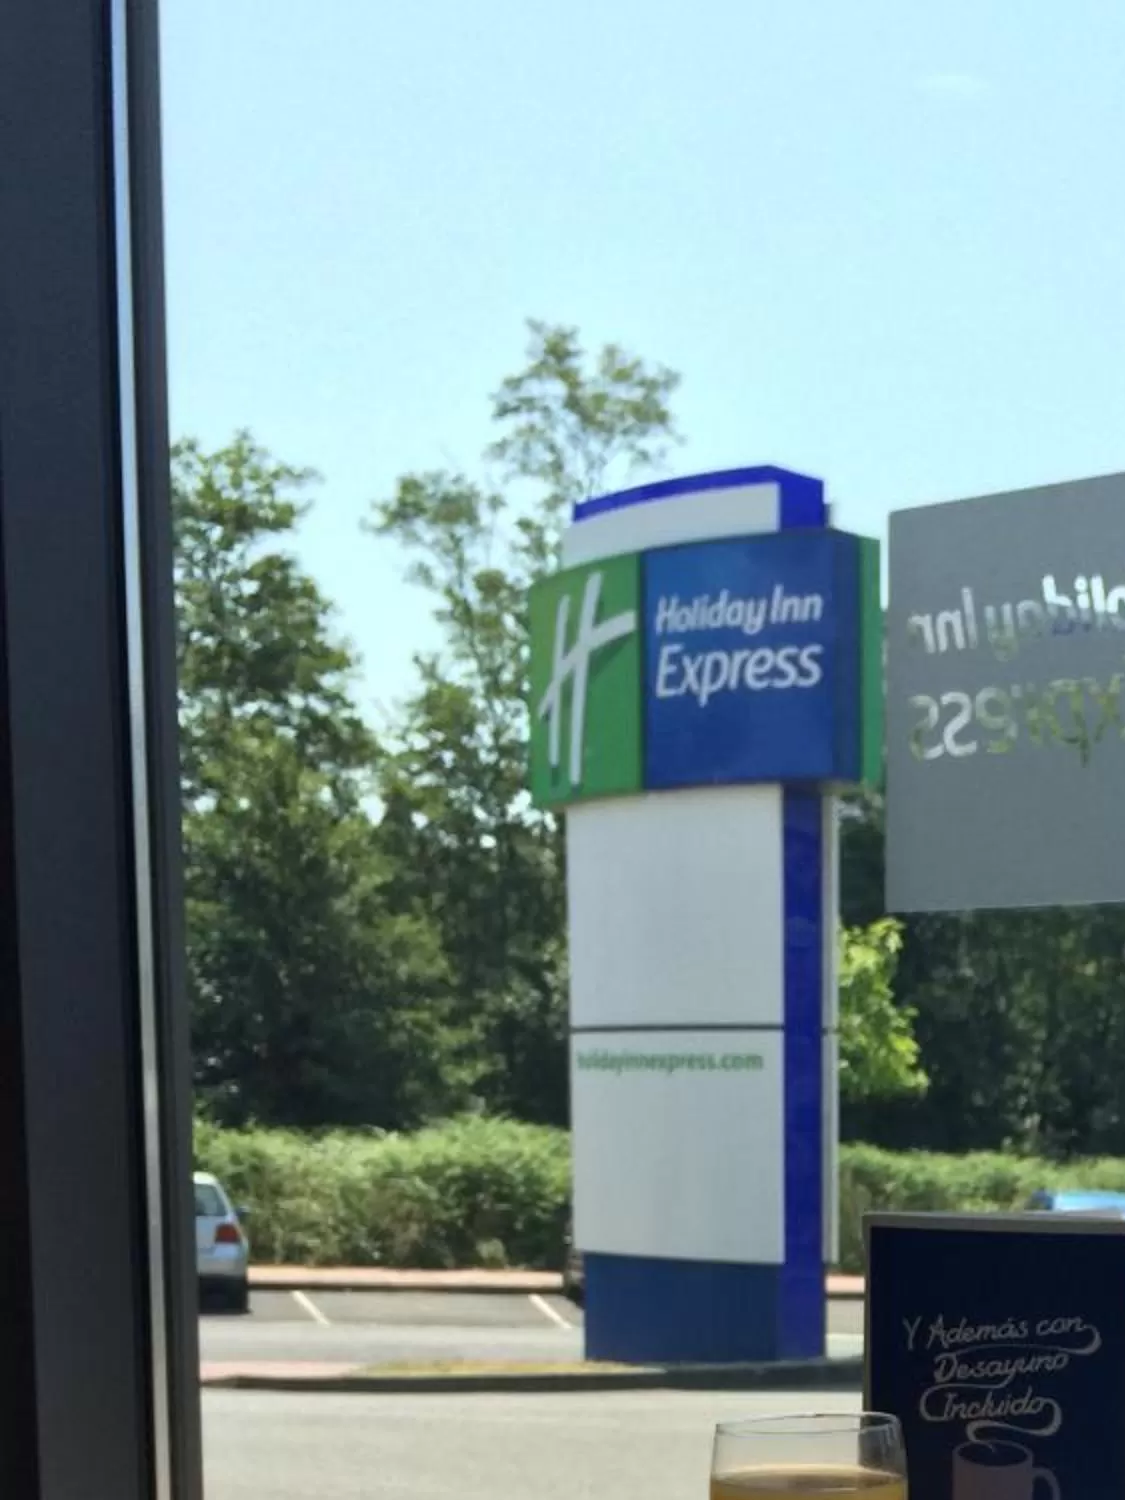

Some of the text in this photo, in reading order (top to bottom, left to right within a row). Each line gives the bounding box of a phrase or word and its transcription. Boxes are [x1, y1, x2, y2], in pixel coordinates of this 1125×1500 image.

[656, 583, 824, 635] Holiday Inn
[656, 642, 825, 708] Express
[902, 1315, 923, 1351] Y
[926, 1313, 1029, 1349] Además
[933, 1351, 1070, 1388] Desayuno
